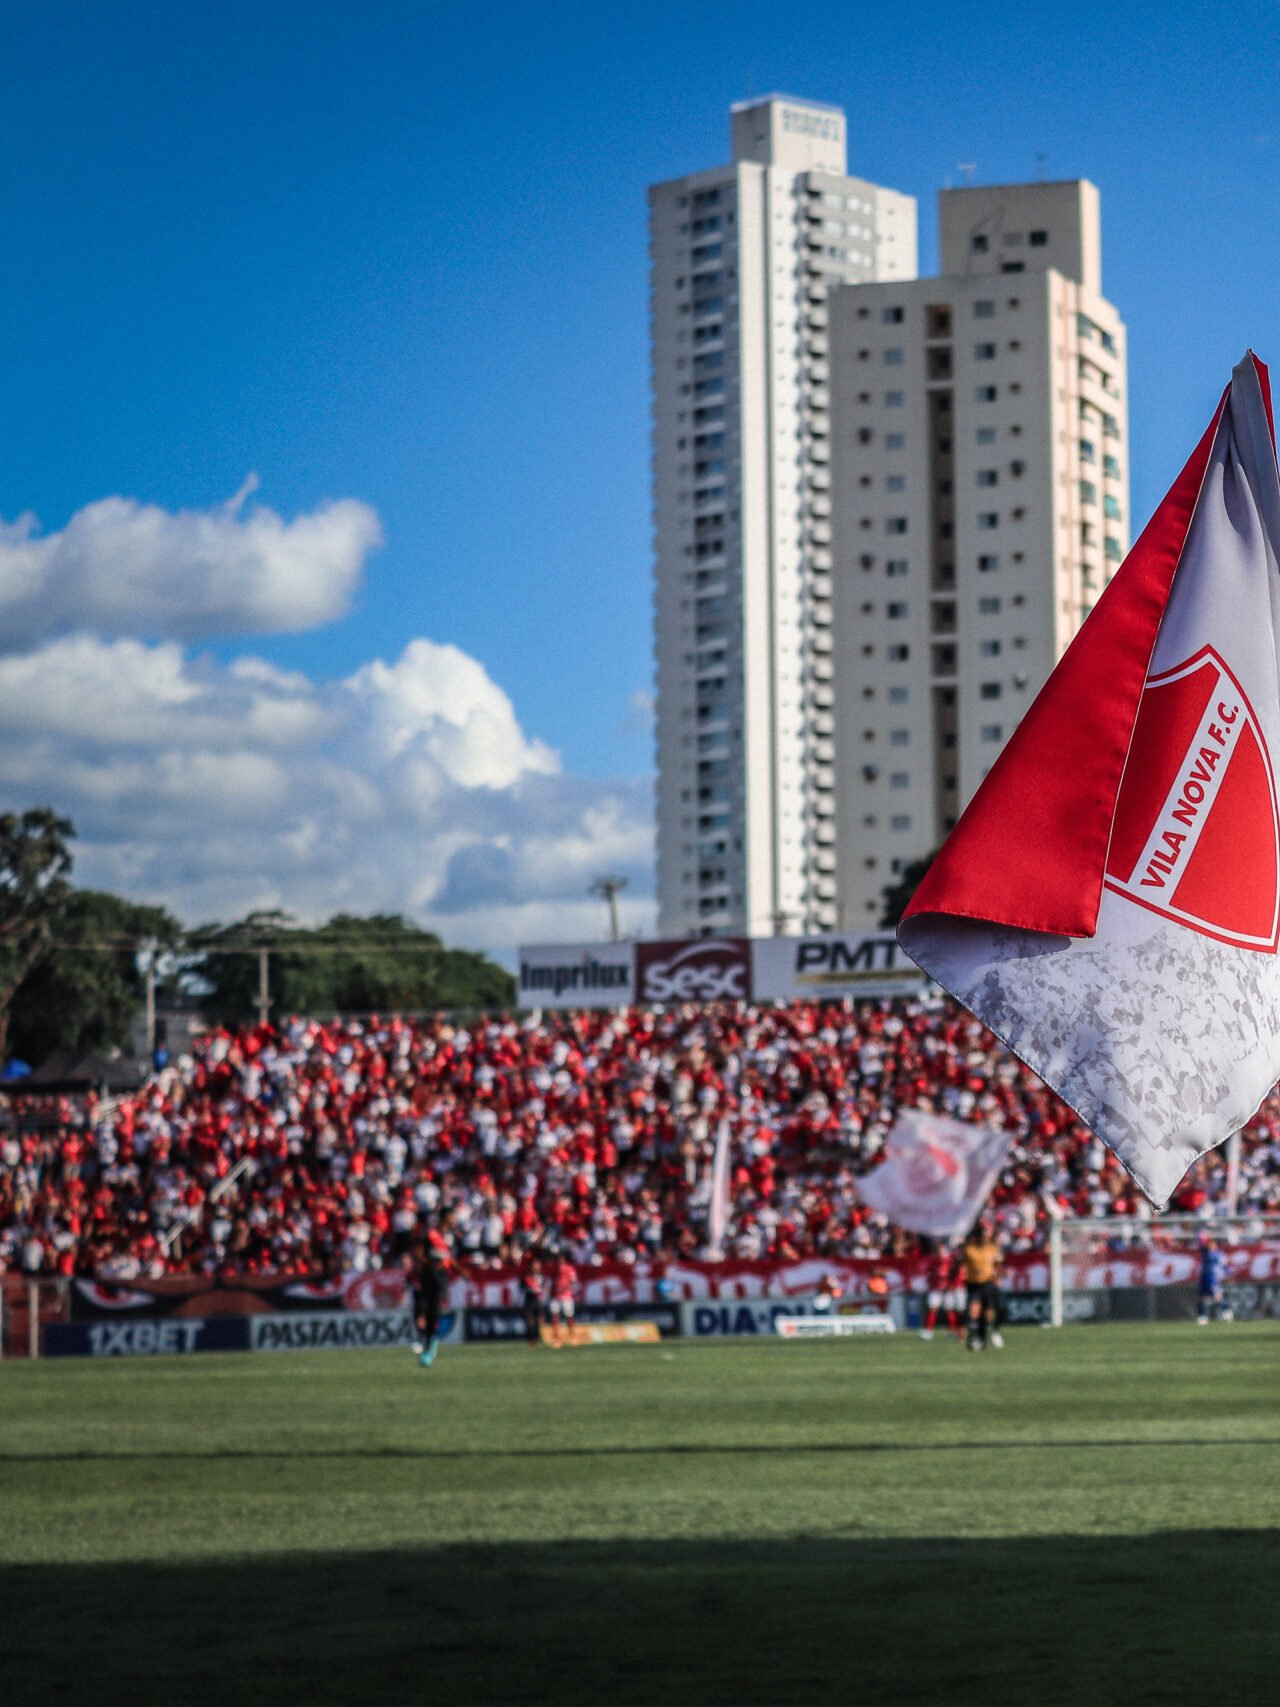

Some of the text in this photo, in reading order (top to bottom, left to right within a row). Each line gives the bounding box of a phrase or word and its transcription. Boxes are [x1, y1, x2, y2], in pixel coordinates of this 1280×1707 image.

[1140, 702, 1240, 888] VILA NOVA F.C.
[520, 954, 629, 997] Imprilux
[88, 1321, 205, 1355] 1XBET
